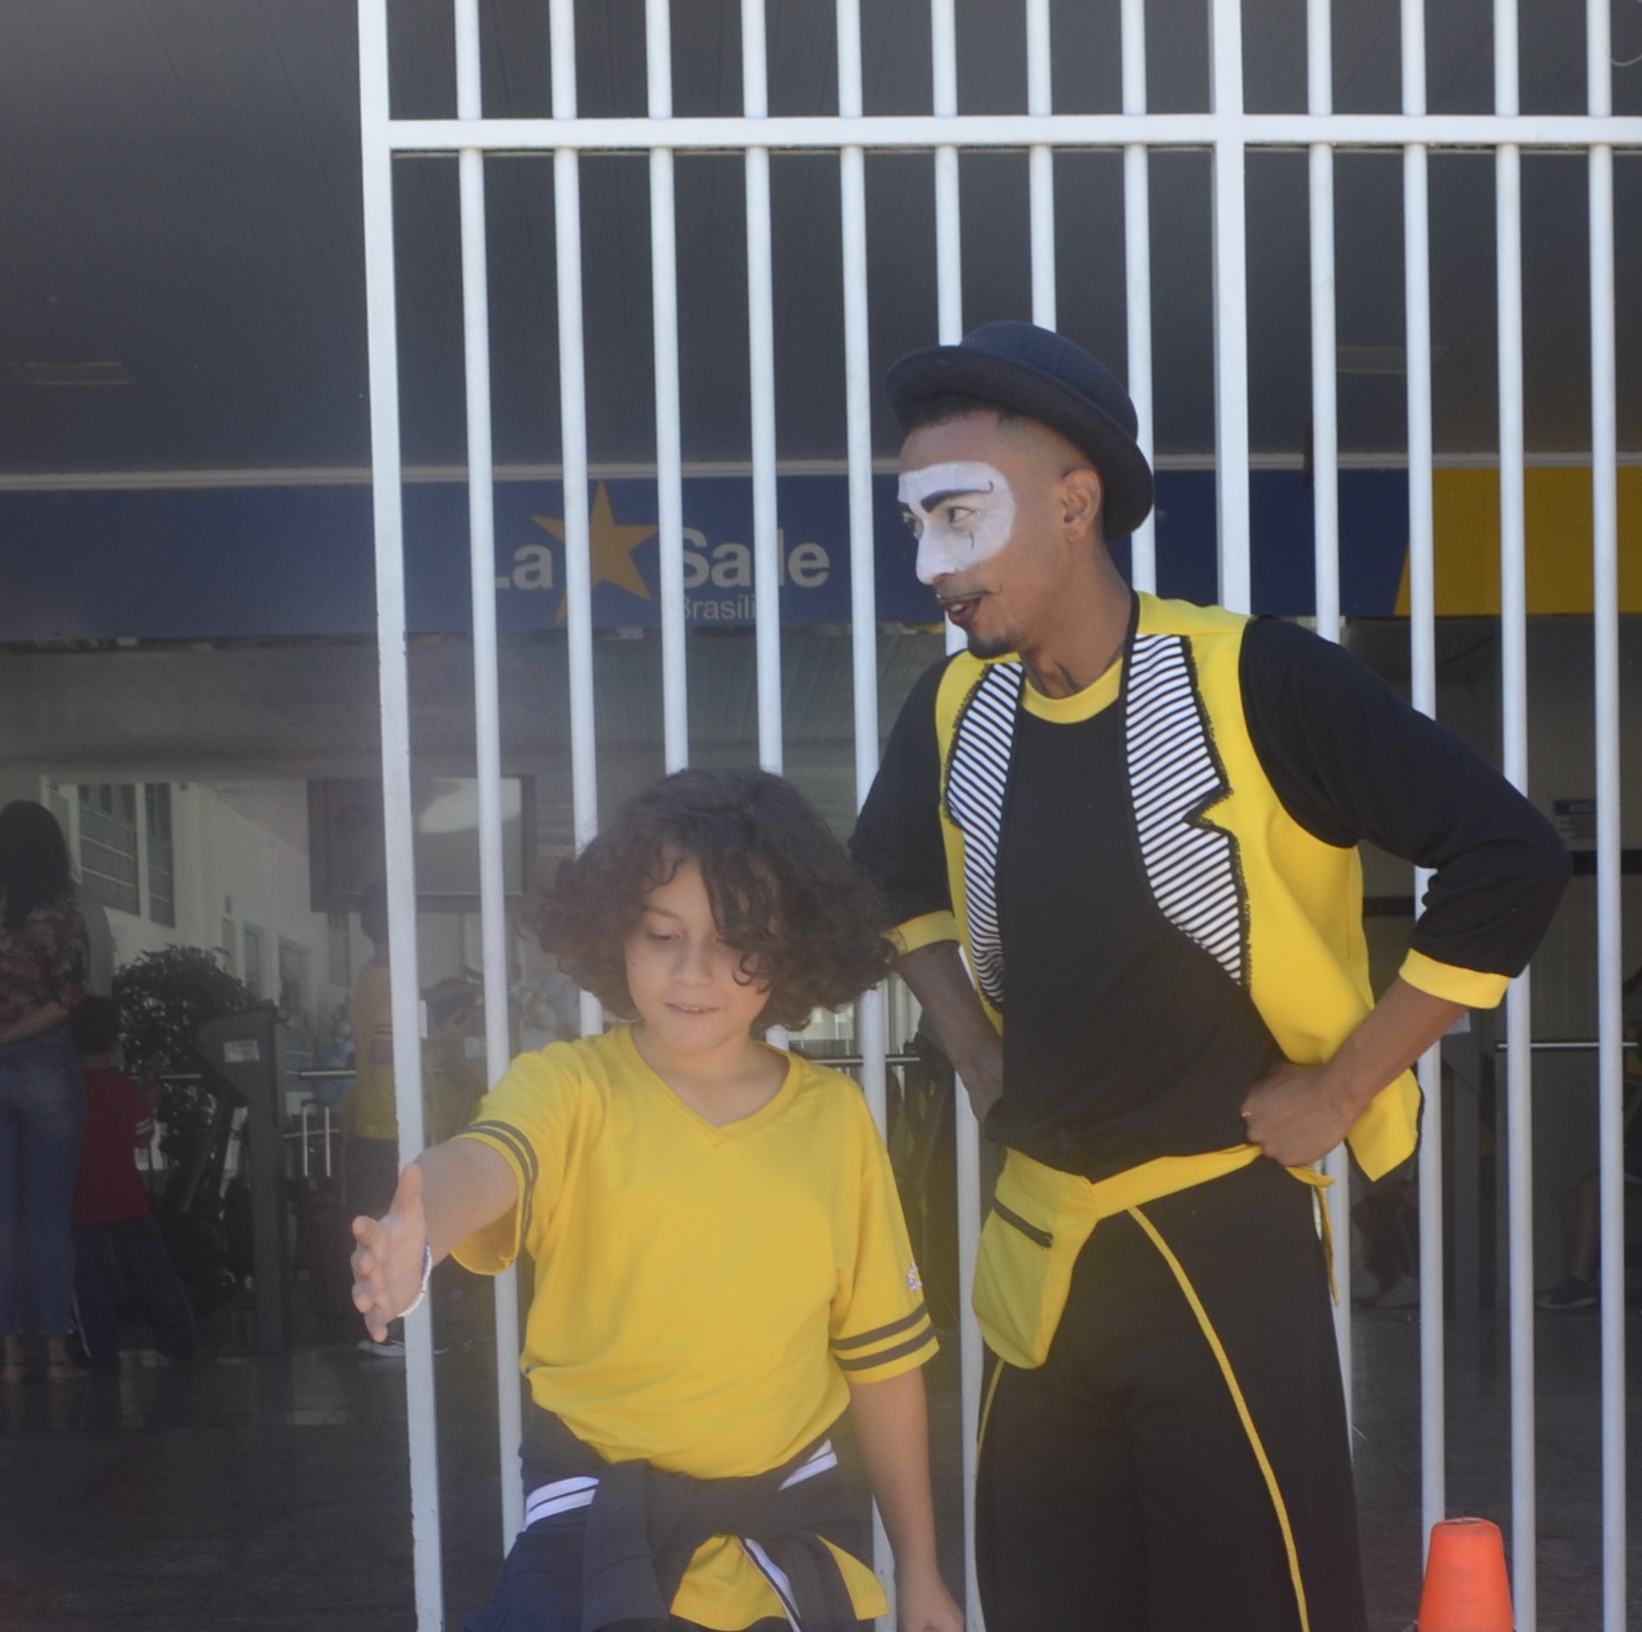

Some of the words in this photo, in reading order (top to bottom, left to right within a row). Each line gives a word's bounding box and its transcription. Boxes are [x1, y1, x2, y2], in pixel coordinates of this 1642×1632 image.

[495, 544, 554, 590] a
[681, 526, 831, 590] Sale
[682, 594, 756, 621] Brasíli
